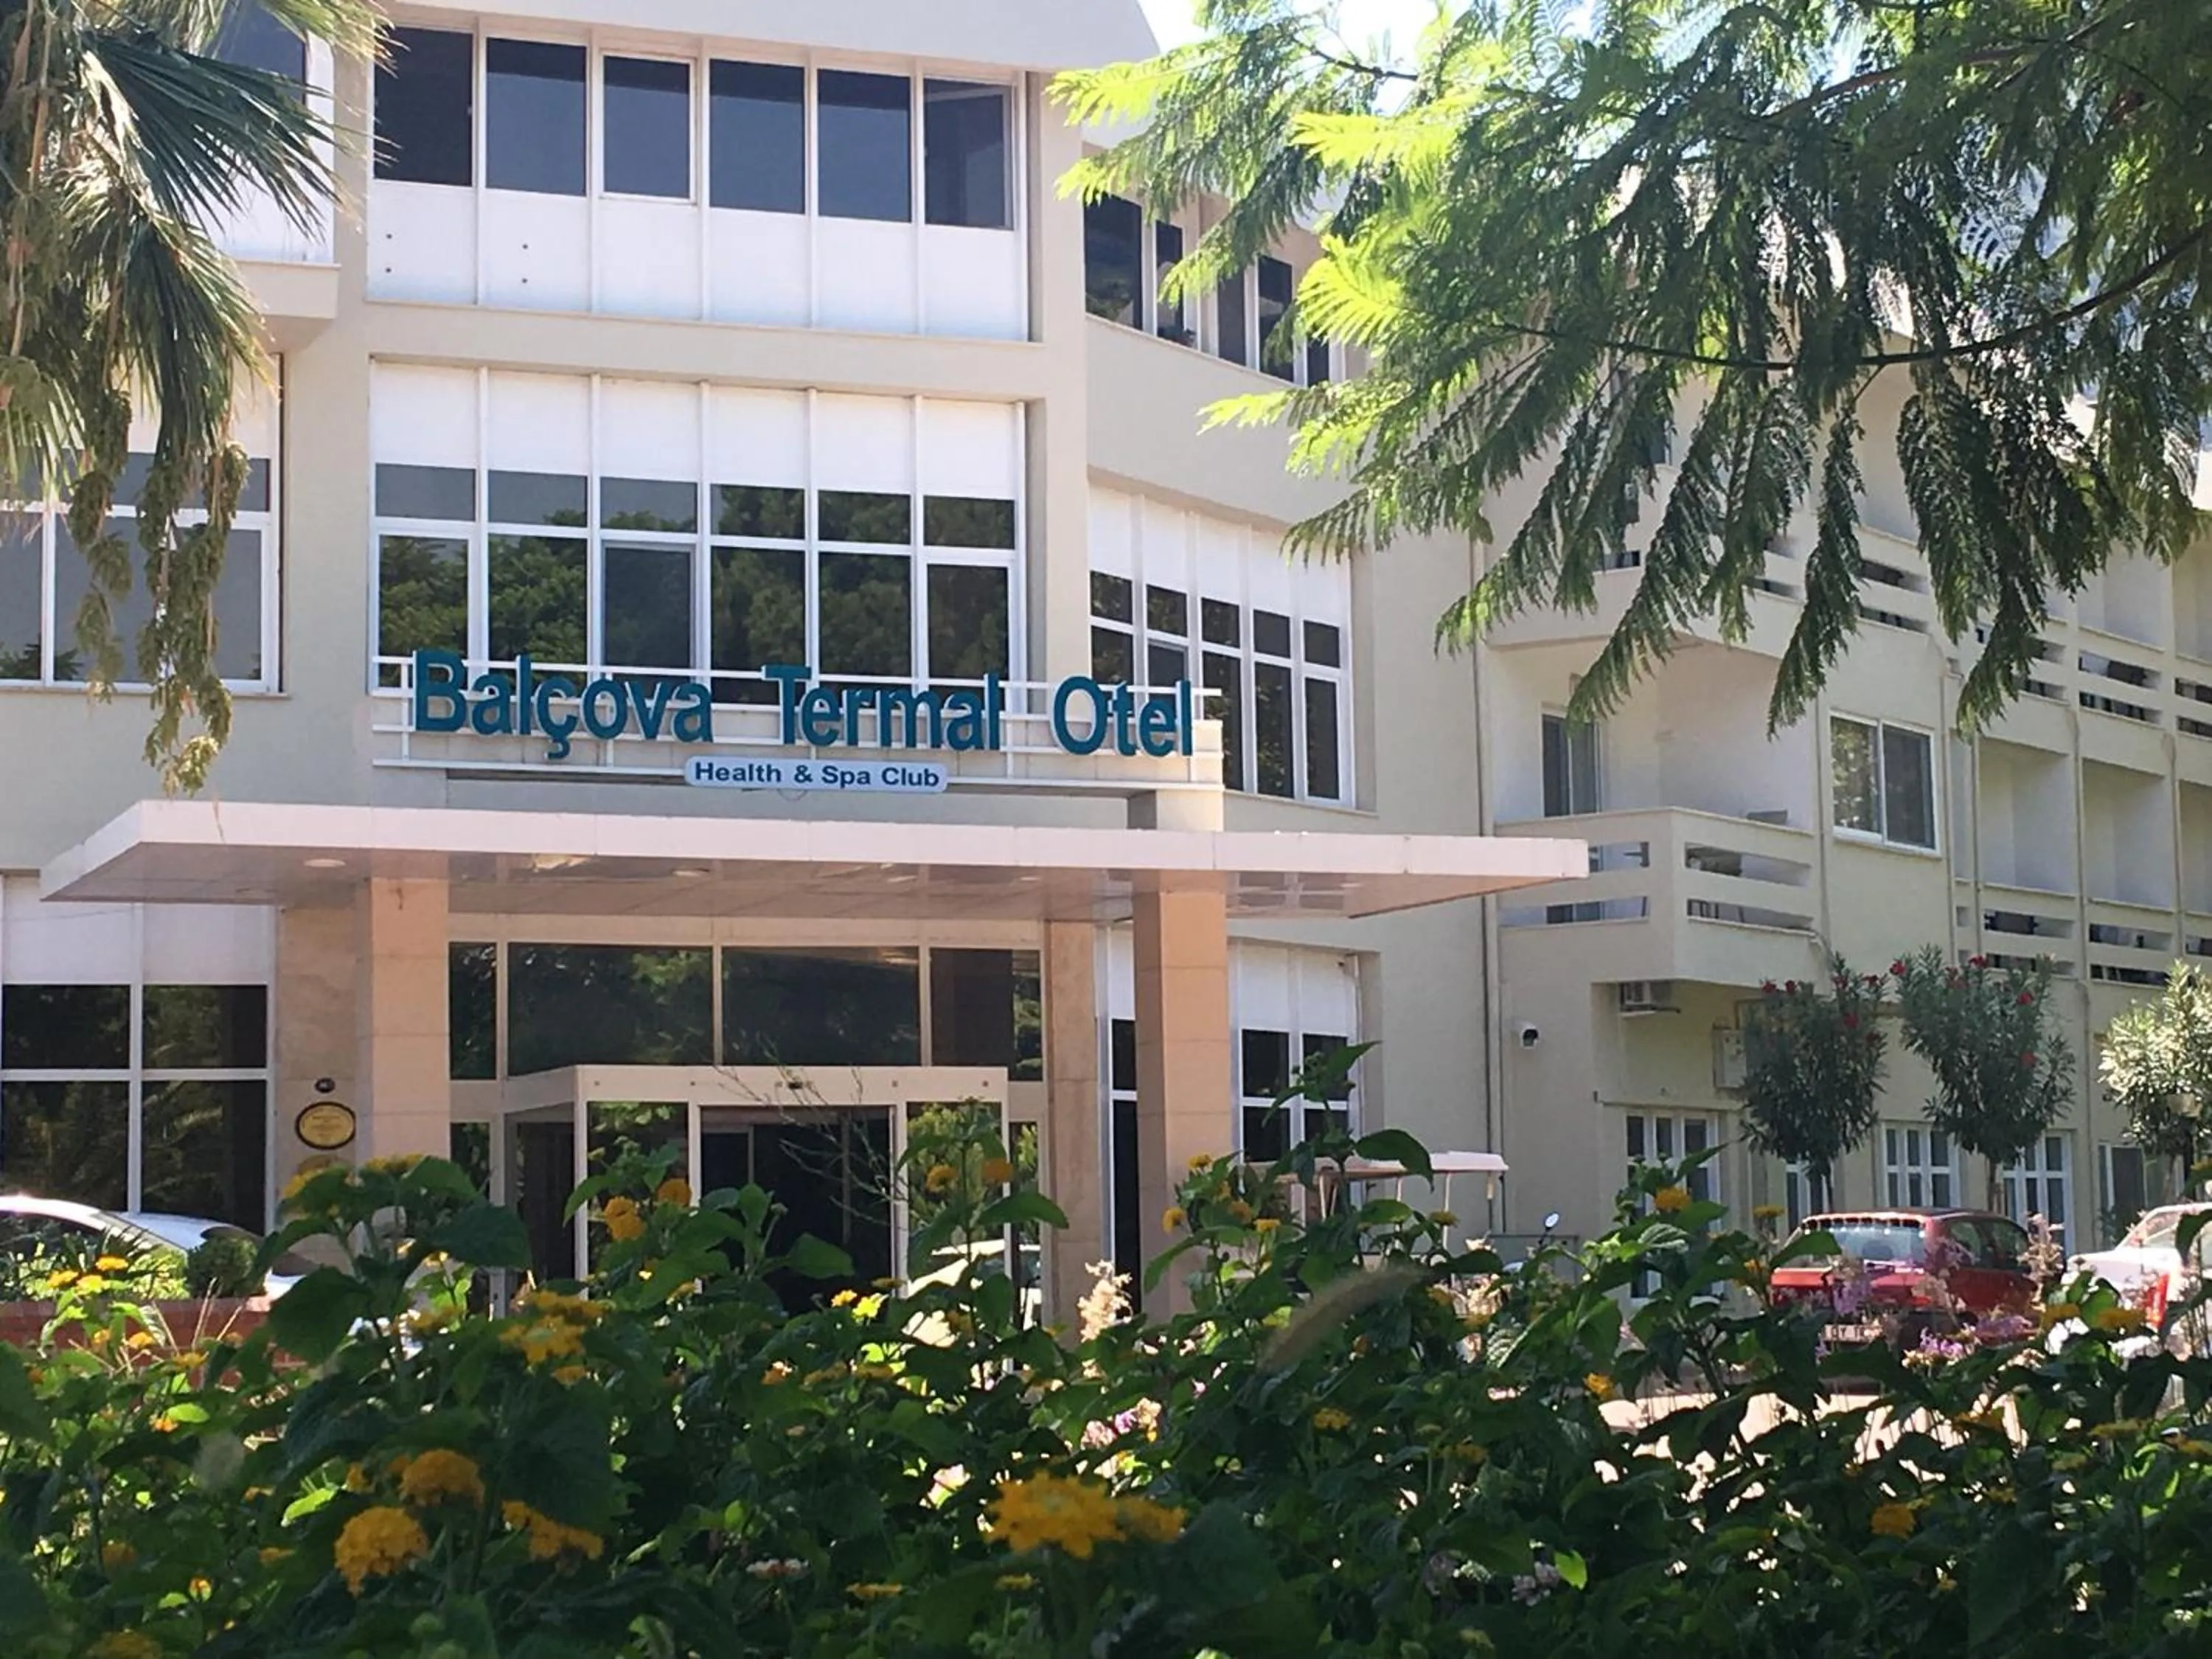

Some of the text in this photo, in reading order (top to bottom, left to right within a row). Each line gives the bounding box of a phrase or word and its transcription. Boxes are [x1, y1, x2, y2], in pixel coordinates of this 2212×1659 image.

[413, 648, 1193, 759] Balçova Termal Otel
[695, 762, 939, 788] Health & Spa Club
